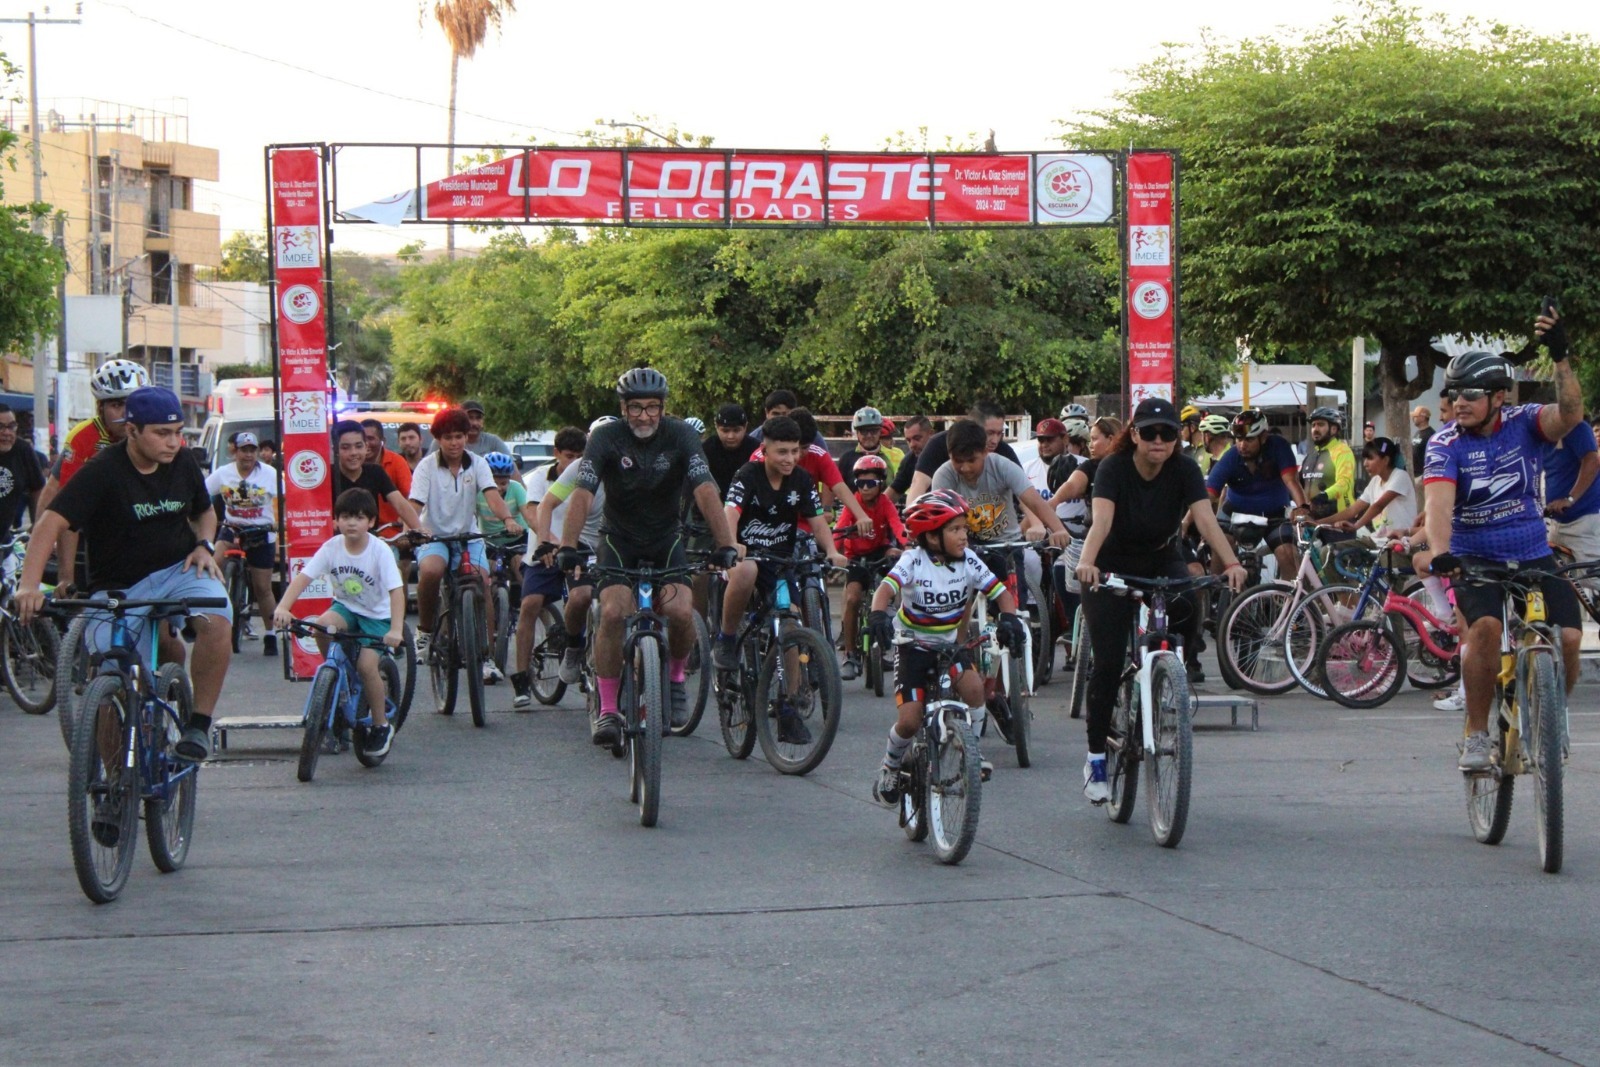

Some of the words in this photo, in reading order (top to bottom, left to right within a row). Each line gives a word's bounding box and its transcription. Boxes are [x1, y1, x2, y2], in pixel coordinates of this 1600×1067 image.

[508, 159, 591, 196] LO
[619, 160, 950, 200] LOGRASTE
[955, 169, 963, 180] Dr.
[982, 169, 987, 180] A.
[1002, 169, 1026, 180] Simental
[439, 180, 469, 190] Presidente
[470, 180, 498, 193] Municipal
[962, 185, 991, 195] Presidente
[993, 185, 1019, 198] Municipal
[452, 196, 466, 206] 2024
[471, 196, 484, 206] 2027
[976, 200, 988, 210] 2024
[993, 200, 1006, 210] 2027
[607, 202, 859, 219] FELICIDADES
[283, 254, 313, 262] IMDEE
[1135, 252, 1164, 260] IMDEE
[290, 419, 320, 428] IMDEE
[1468, 451, 1485, 459] VISA
[133, 502, 158, 520] RICK
[1493, 505, 1525, 520] SERVICE
